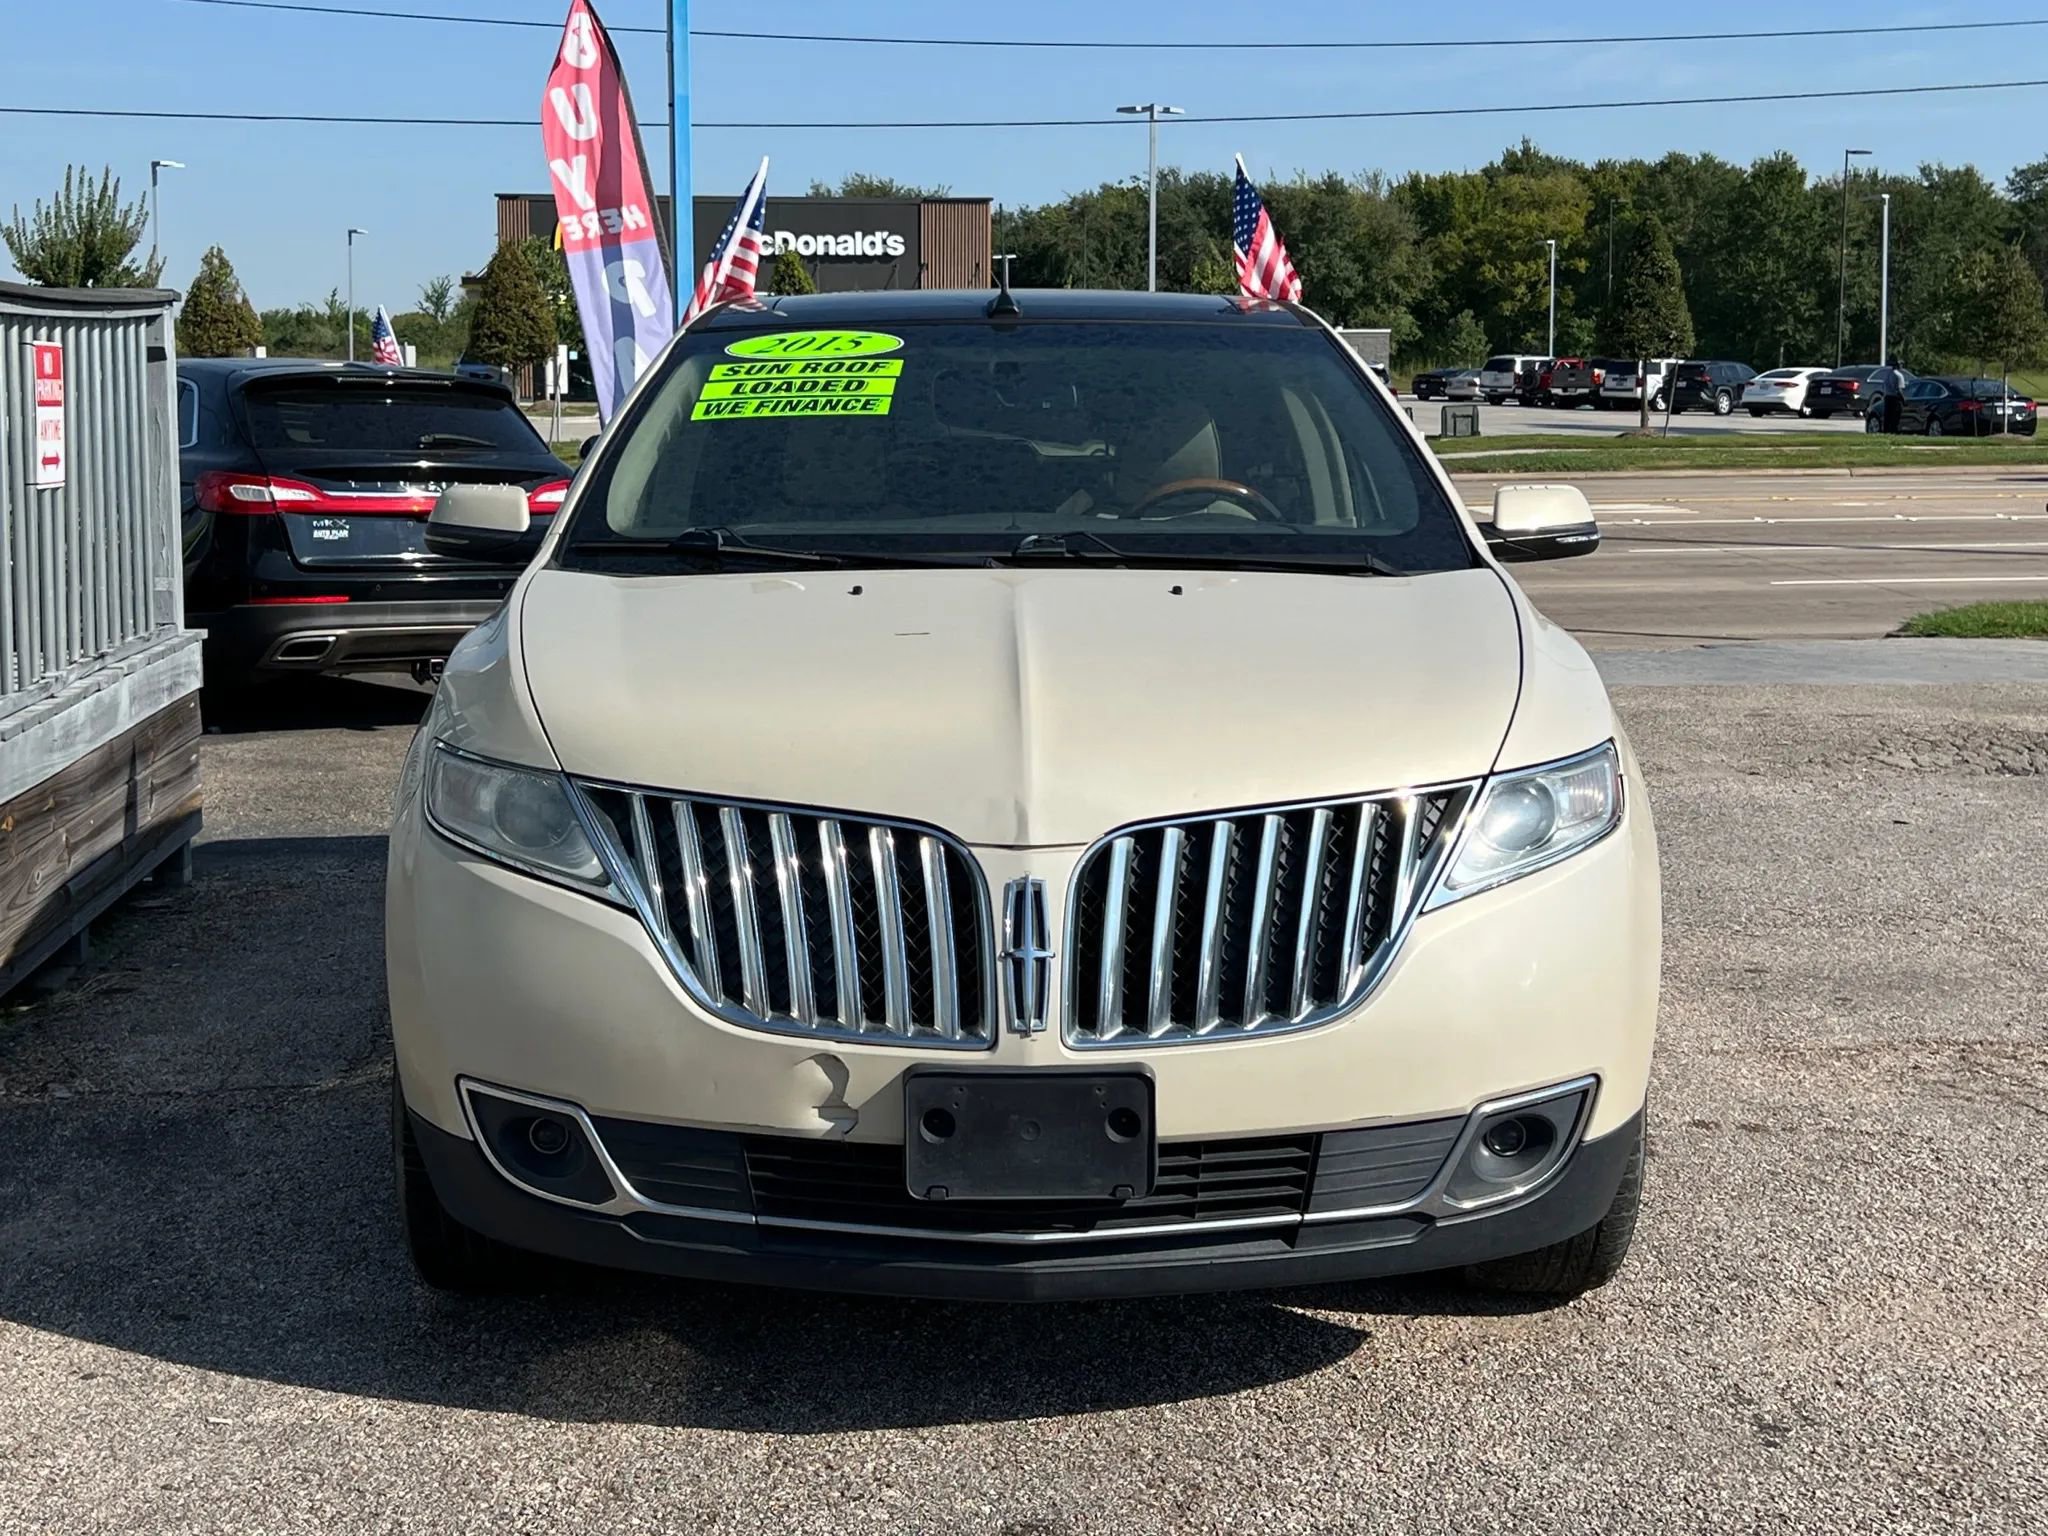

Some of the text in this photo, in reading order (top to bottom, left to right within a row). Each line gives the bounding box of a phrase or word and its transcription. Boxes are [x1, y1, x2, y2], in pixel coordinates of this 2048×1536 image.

[760, 230, 905, 256] cDonald's
[750, 335, 873, 354] 2015
[43, 352, 54, 376] NO
[722, 360, 890, 377] SUN ROOF
[36, 379, 61, 401] PARKING
[730, 378, 869, 396] LOADED
[703, 397, 881, 417] WE FINANCE
[312, 519, 350, 529] MKX
